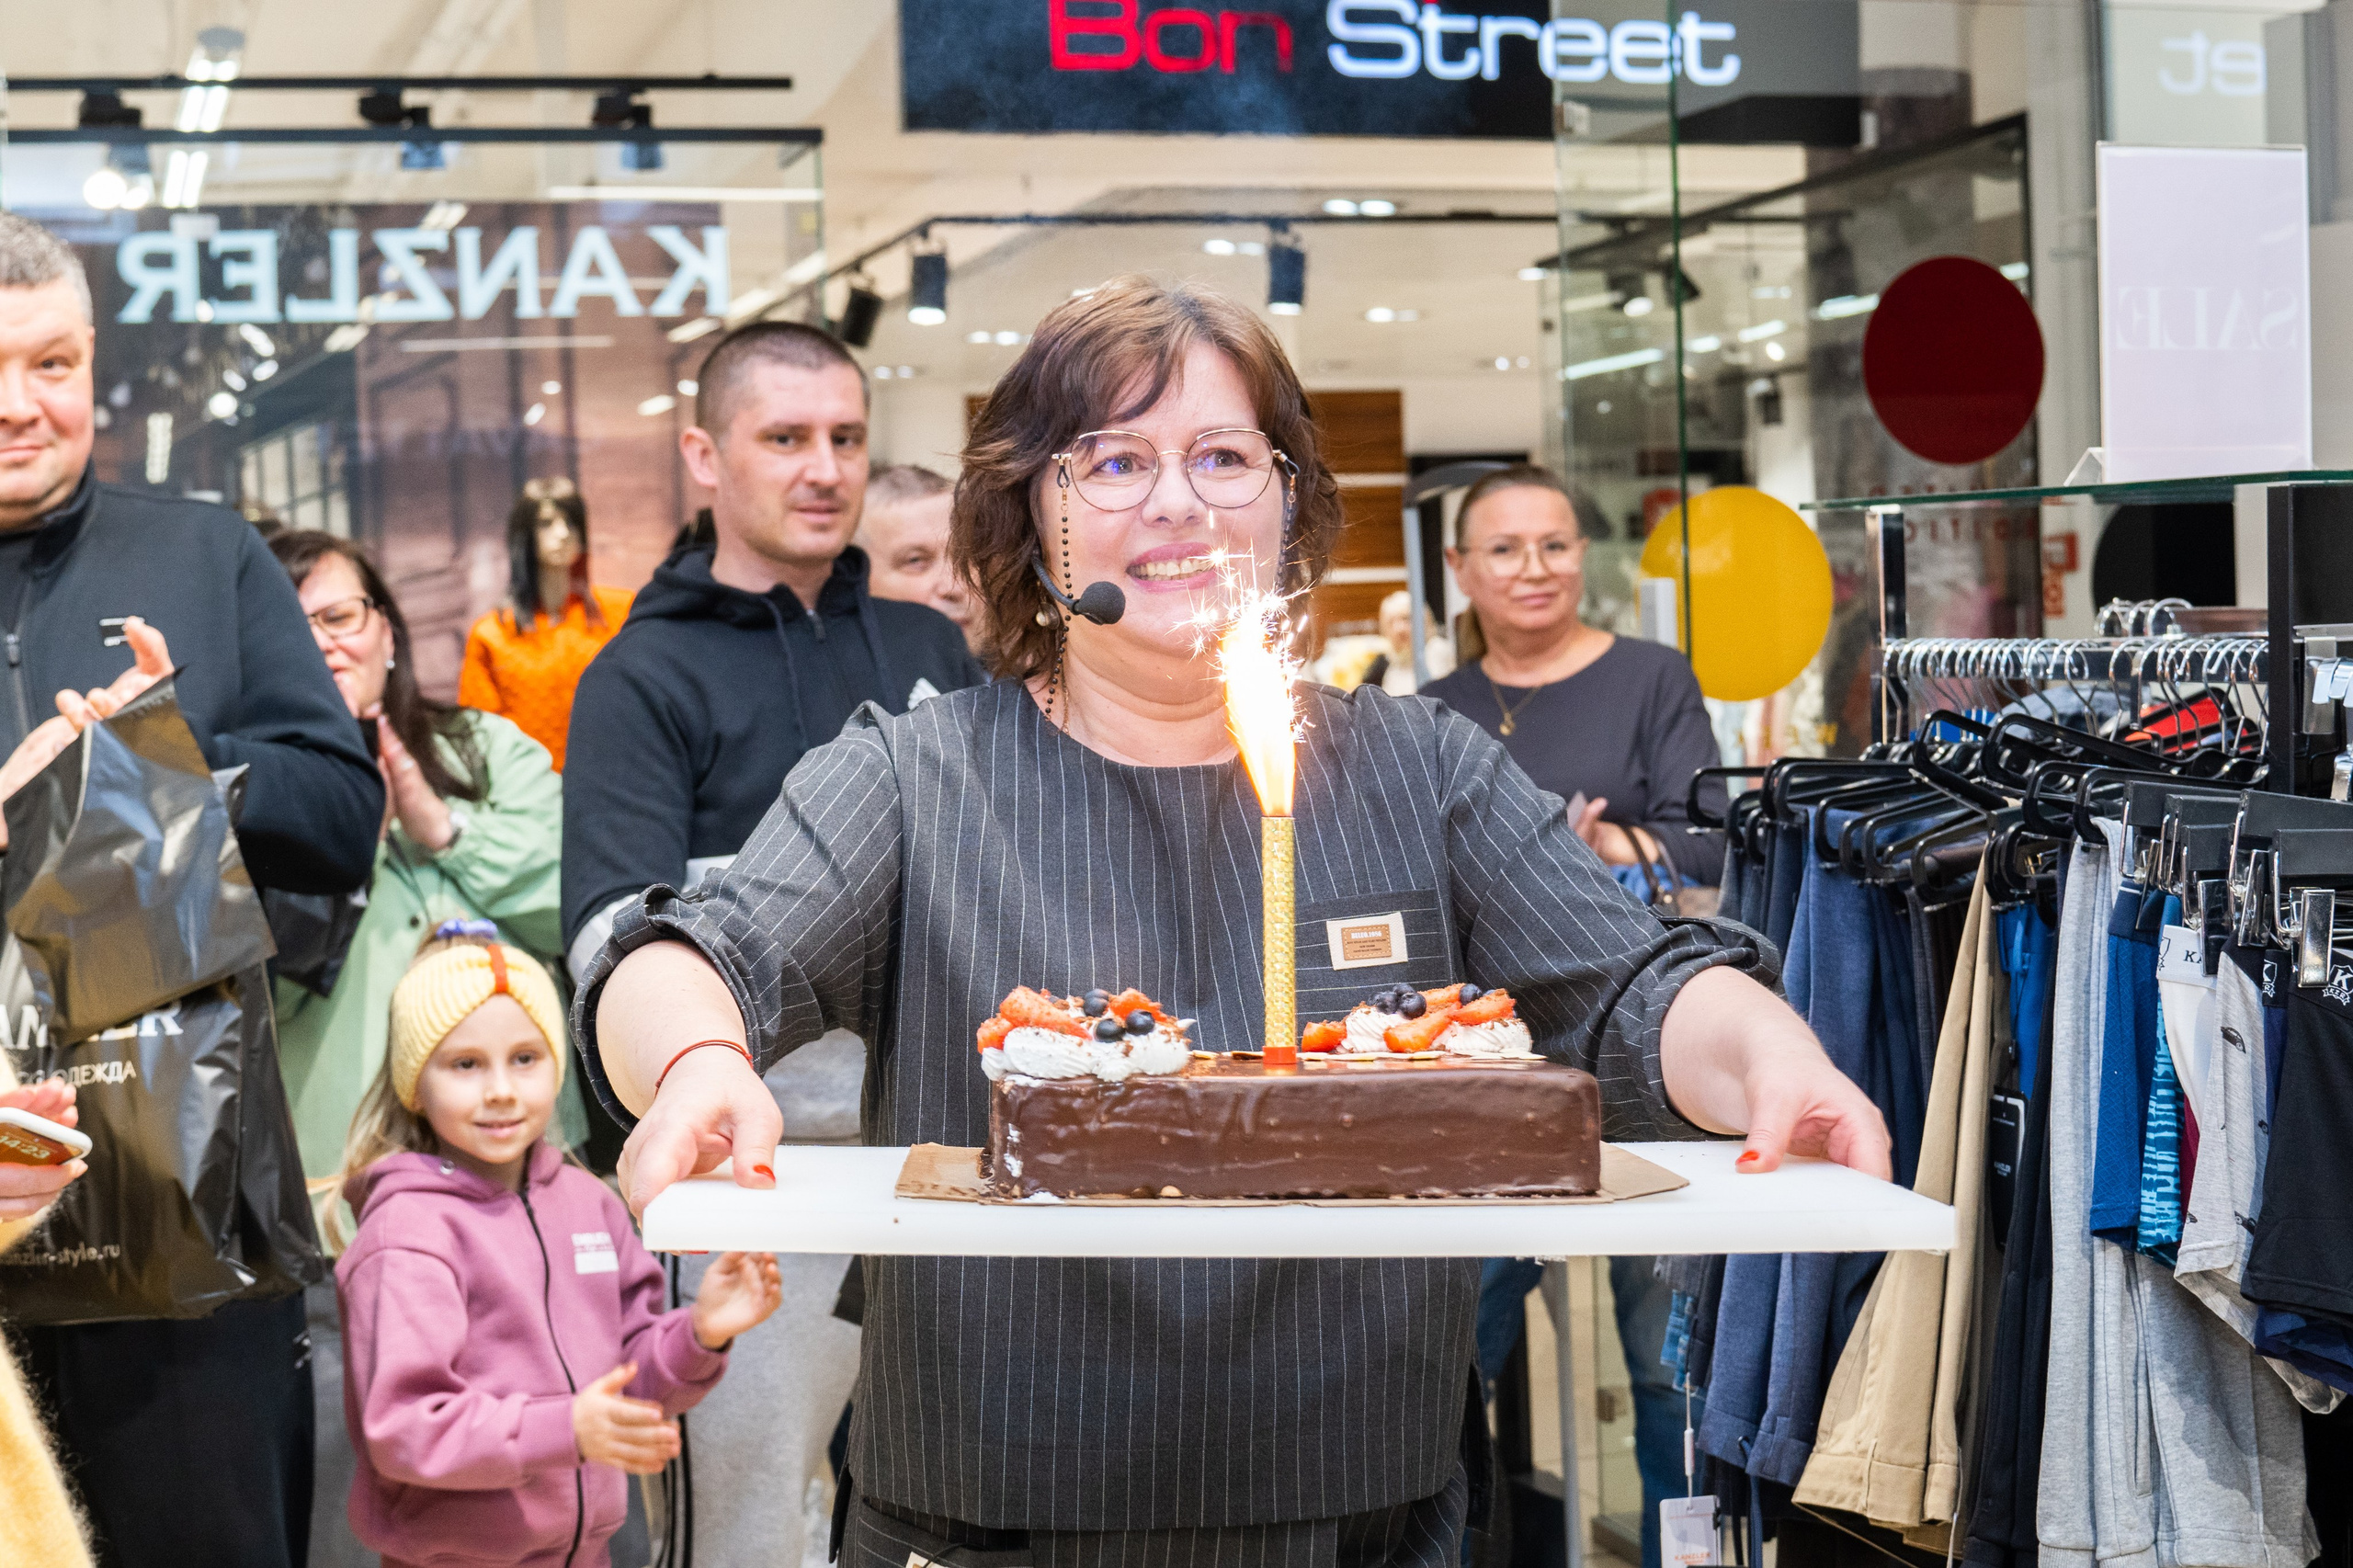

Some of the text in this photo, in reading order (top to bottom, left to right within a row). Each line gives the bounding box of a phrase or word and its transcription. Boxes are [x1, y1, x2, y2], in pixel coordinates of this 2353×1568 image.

[1048, 0, 1742, 86] Bon Street
[2329, 987, 2347, 1000] KZR
